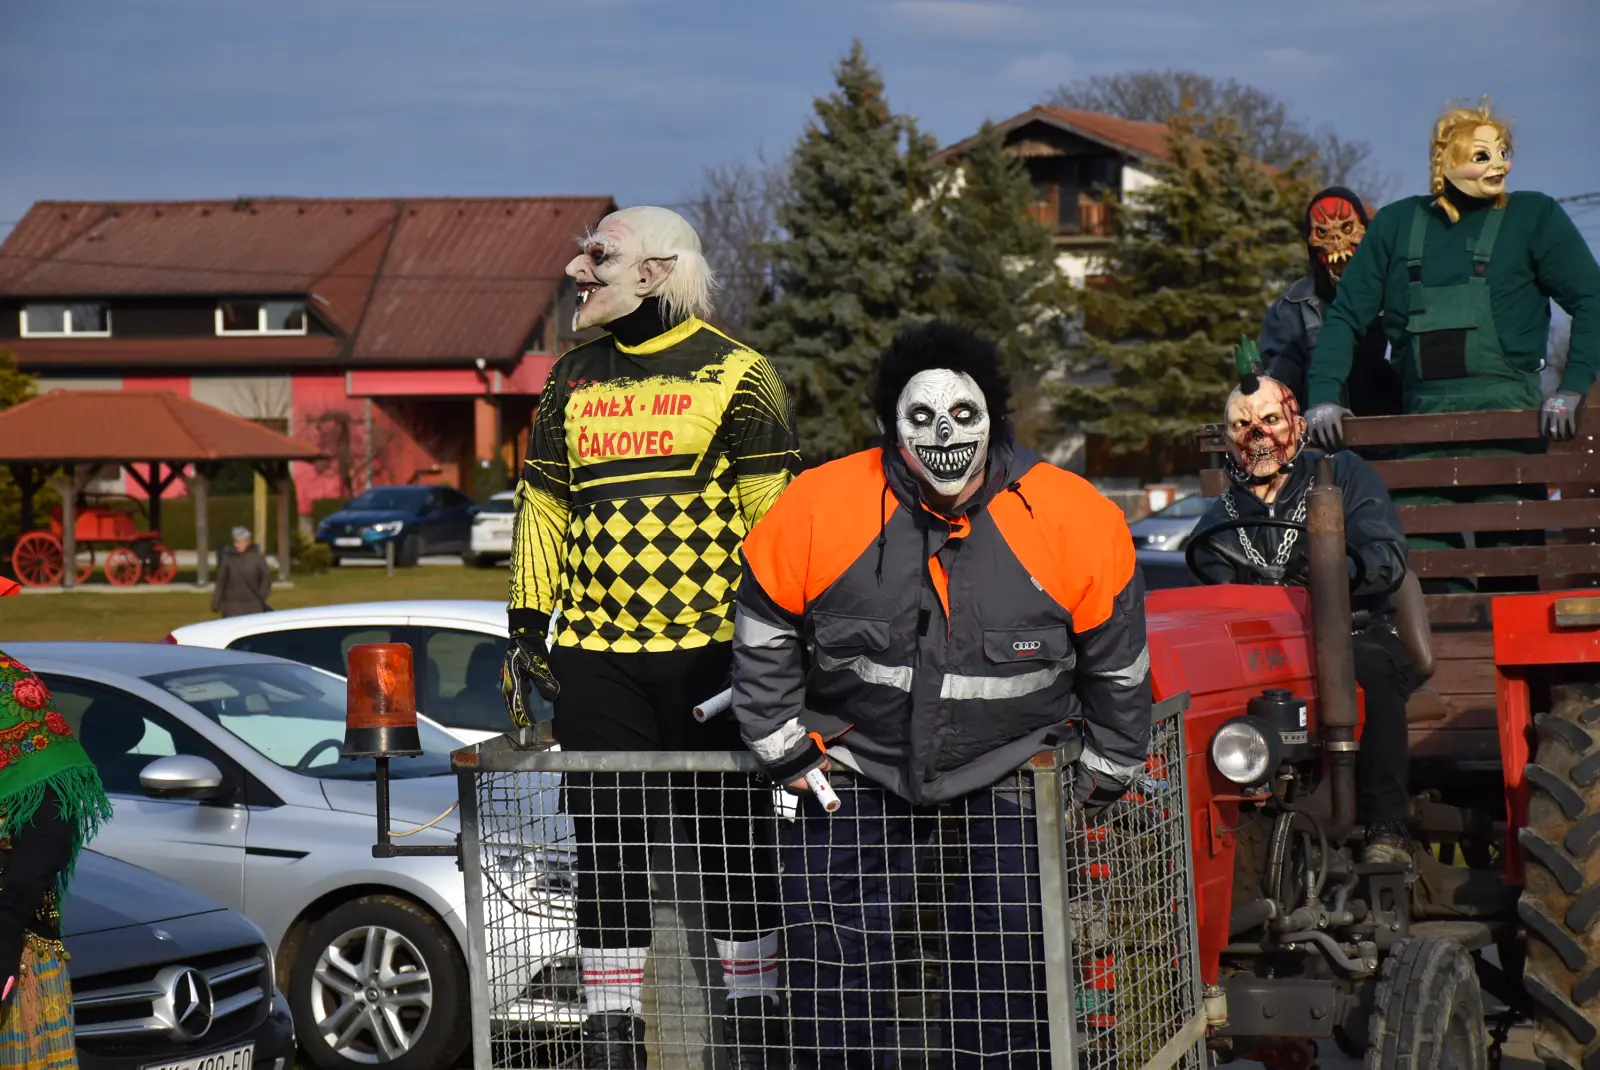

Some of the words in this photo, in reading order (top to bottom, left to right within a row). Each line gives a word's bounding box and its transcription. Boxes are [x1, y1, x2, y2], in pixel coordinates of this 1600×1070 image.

[571, 394, 636, 419] ANEX
[651, 394, 692, 416] MIP
[577, 425, 674, 458] ČAKOVEC
